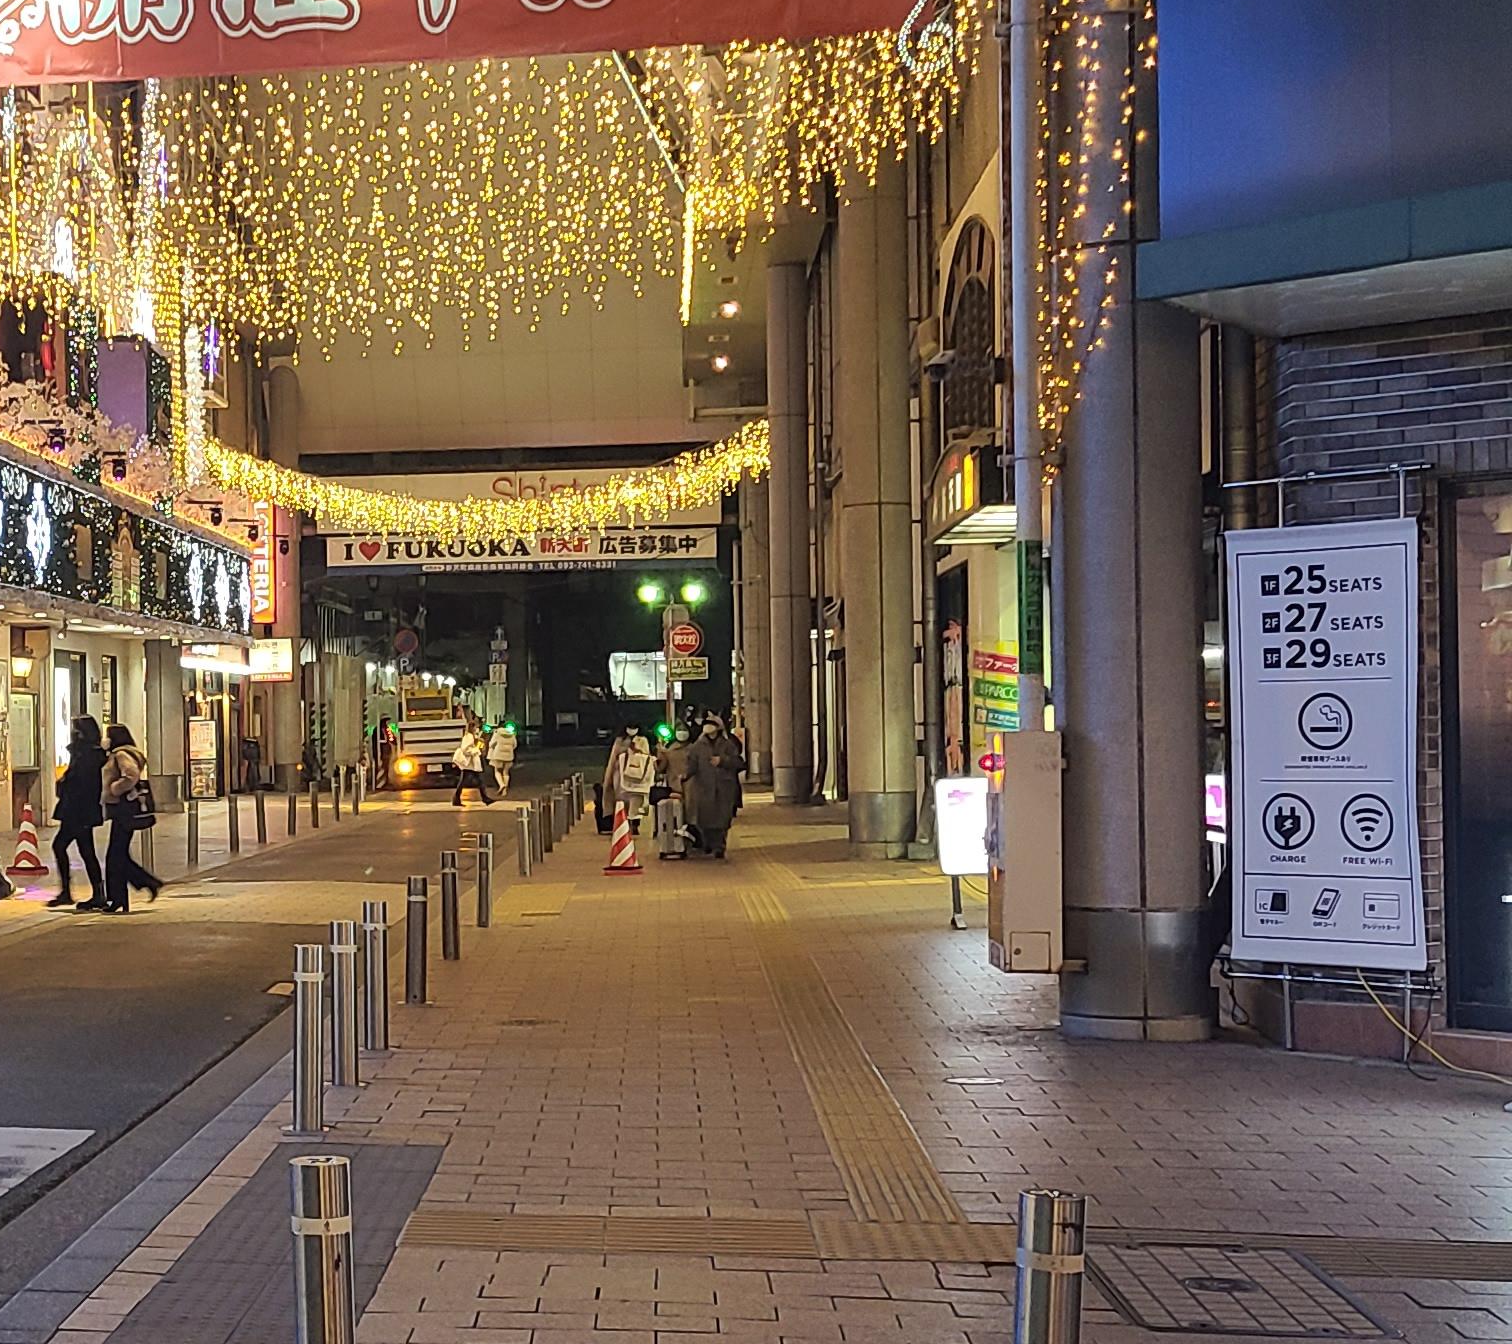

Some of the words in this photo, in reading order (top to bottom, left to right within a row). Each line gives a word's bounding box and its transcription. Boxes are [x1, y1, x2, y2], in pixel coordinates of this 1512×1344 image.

[343, 542, 353, 560] I
[387, 537, 531, 560] FUKUOKA
[598, 535, 697, 555] 広告募集中
[1264, 580, 1277, 591] 1F
[1284, 564, 1327, 595] 25
[1329, 577, 1383, 593] SEATS
[1264, 617, 1279, 629] 2F
[1285, 602, 1327, 632] 27
[1330, 616, 1384, 631] SEATS
[1266, 653, 1279, 664] 3F
[1286, 638, 1331, 668] 29
[1333, 653, 1386, 668] SEATS
[1270, 855, 1306, 863] CHARGE
[1342, 856, 1366, 865] FREE
[1258, 902, 1269, 911] IC
